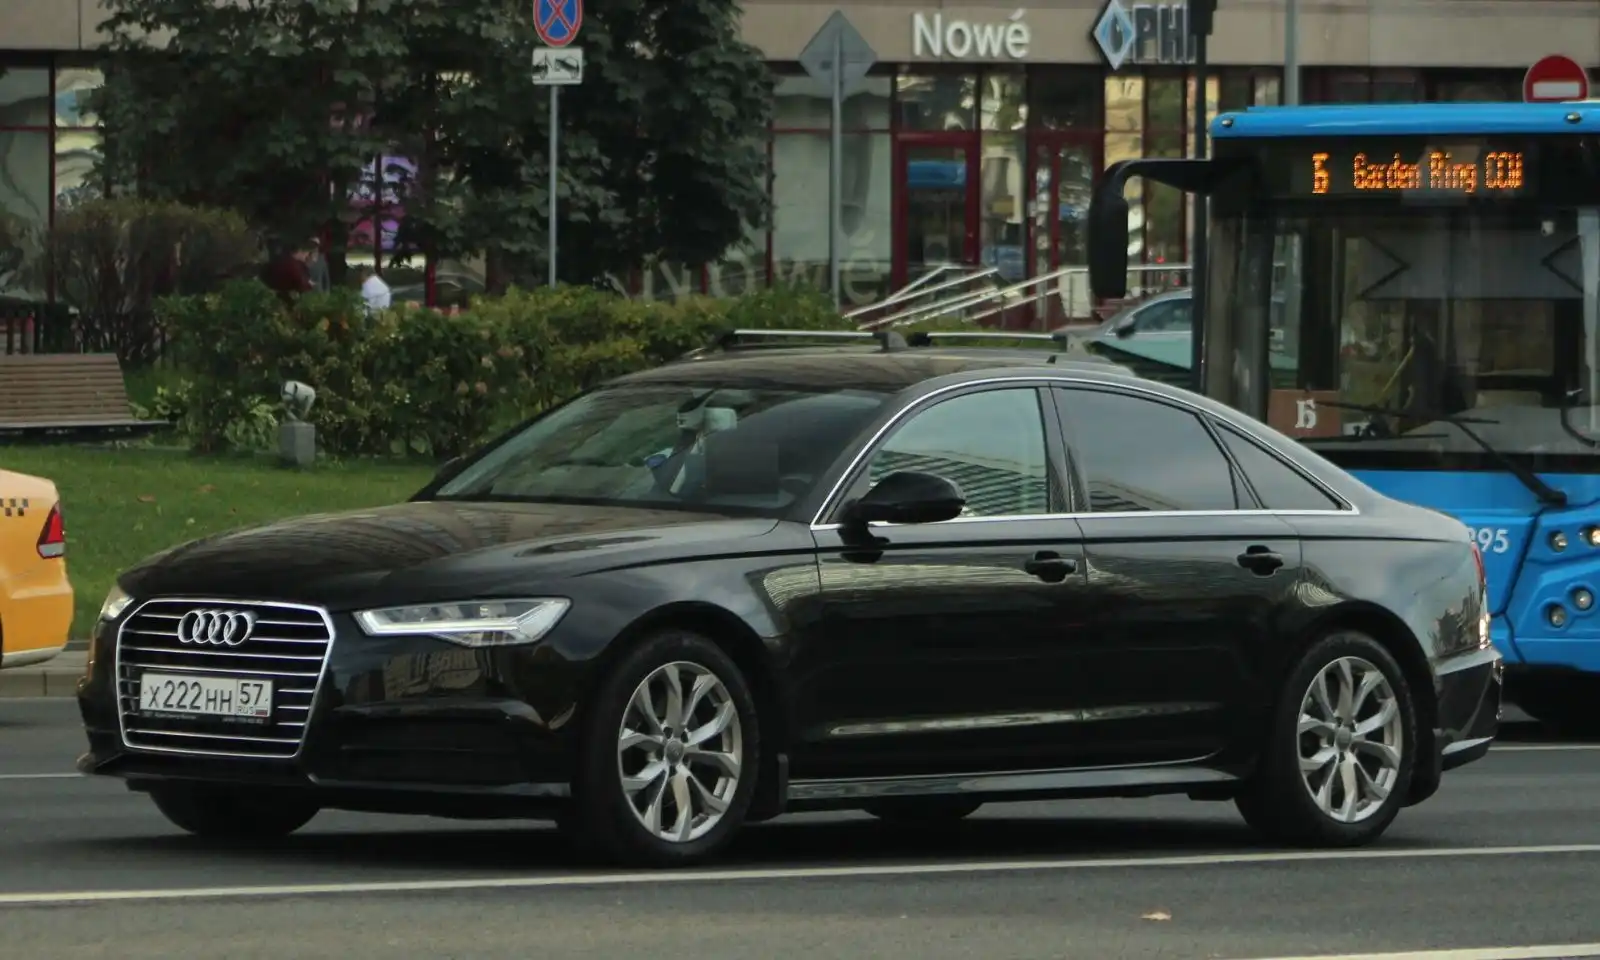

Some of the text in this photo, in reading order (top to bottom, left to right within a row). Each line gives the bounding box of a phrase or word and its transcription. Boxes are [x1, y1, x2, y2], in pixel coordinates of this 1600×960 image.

[913, 8, 1031, 58] Nowé
[1353, 153, 1421, 189] Garden
[1430, 151, 1477, 193] Ring
[1295, 398, 1317, 428] Б
[240, 682, 264, 705] 57
